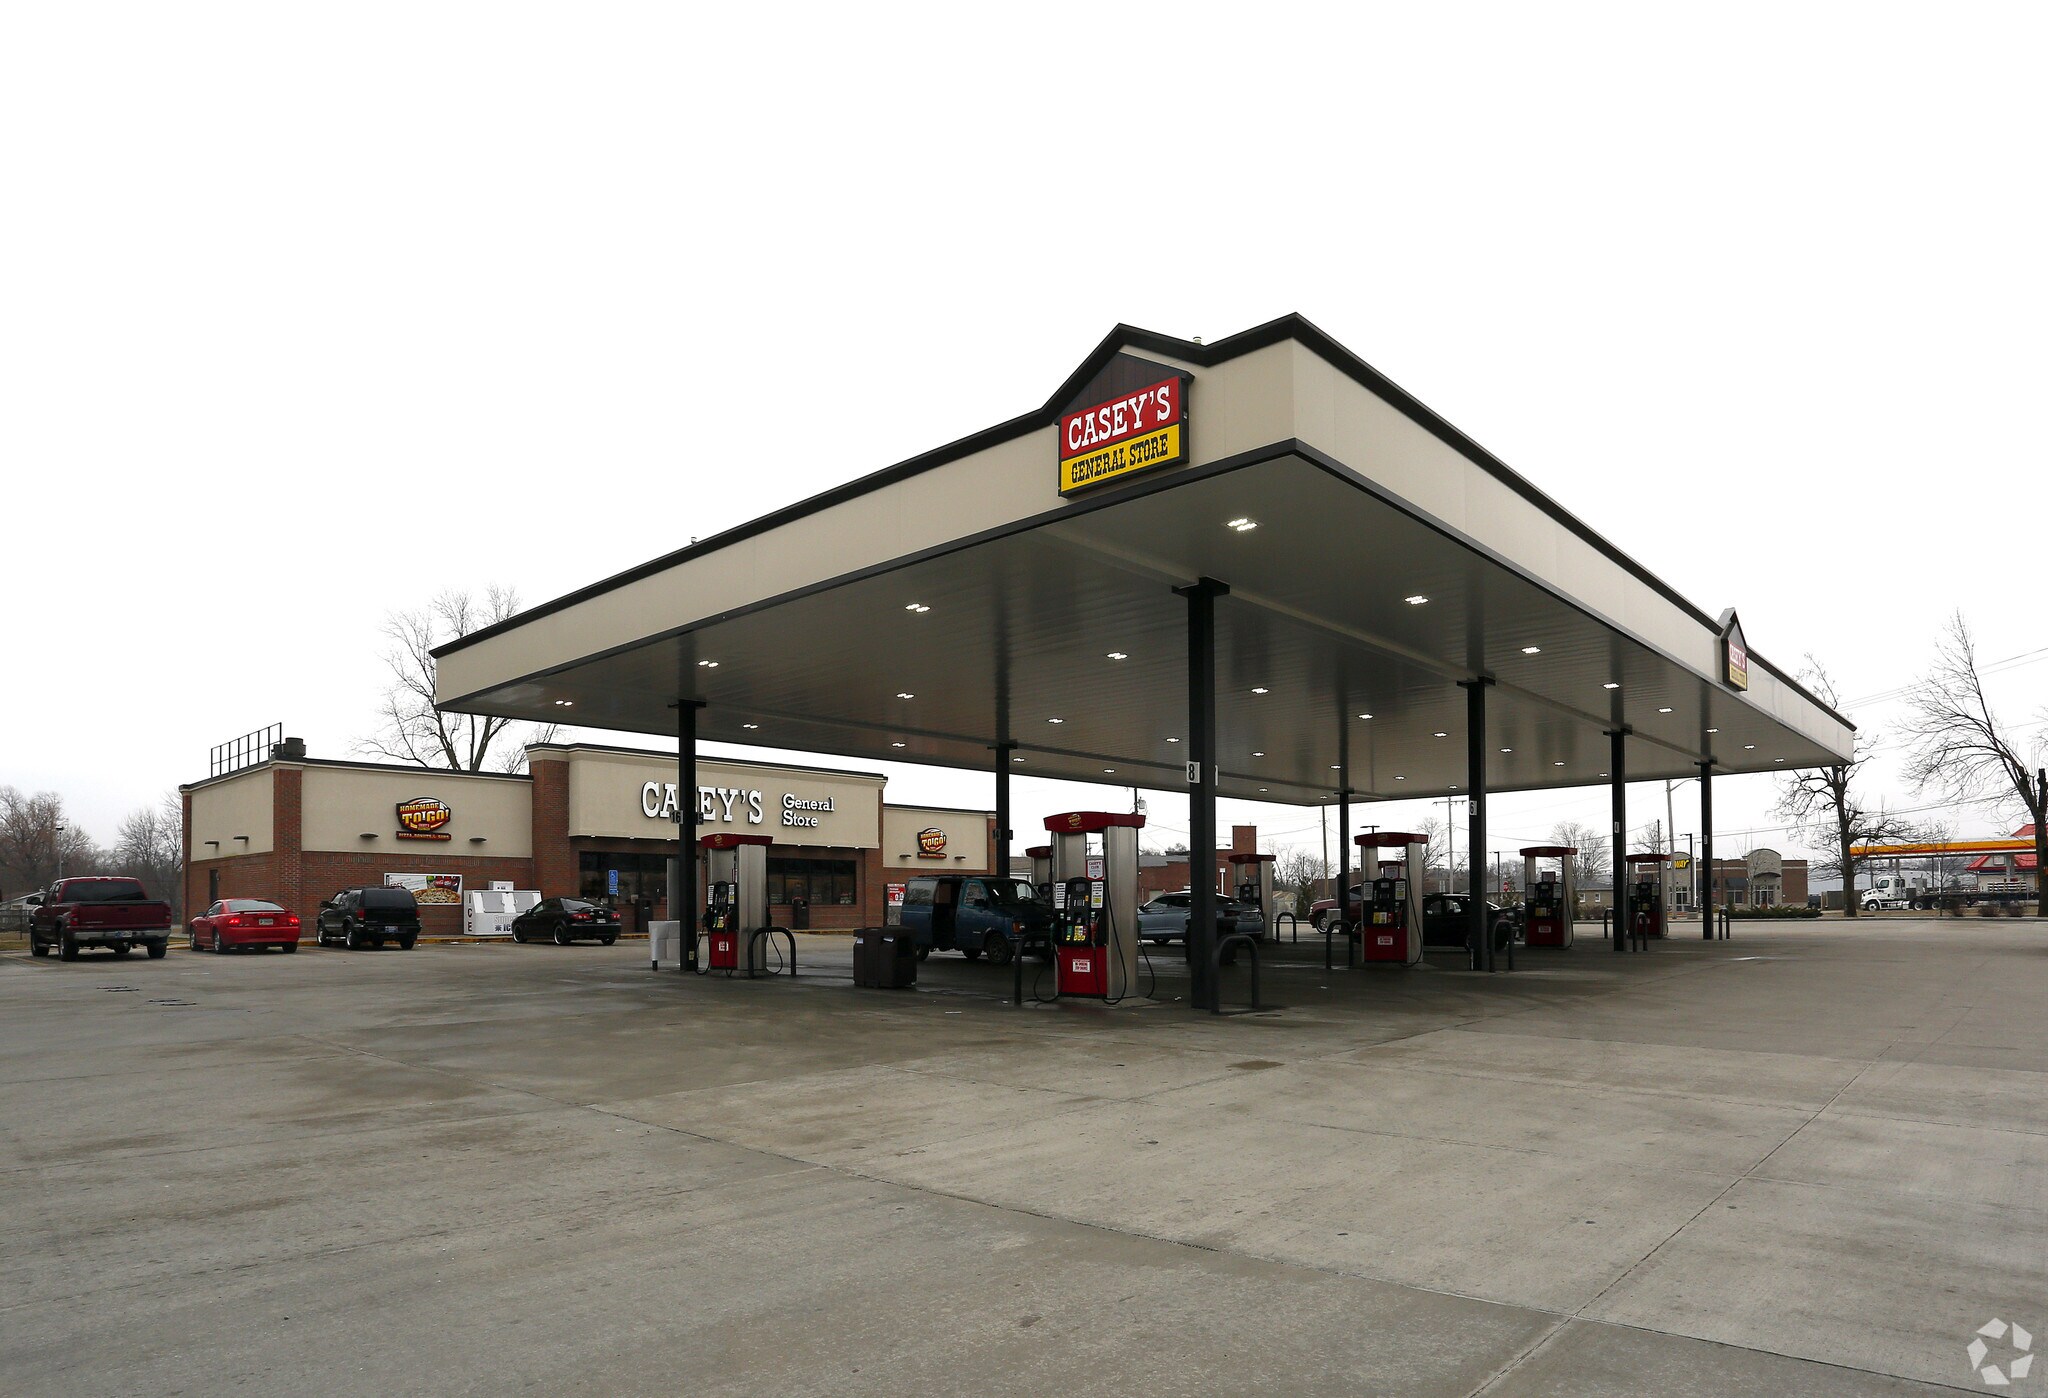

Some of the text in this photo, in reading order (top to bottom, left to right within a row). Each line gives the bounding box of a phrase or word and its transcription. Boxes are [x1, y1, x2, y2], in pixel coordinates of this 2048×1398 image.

[1068, 385, 1171, 450] CASEY'S
[1071, 433, 1168, 483] GENERAL STORE
[1188, 763, 1195, 781] 8
[400, 802, 440, 812] HOMEMADE
[642, 781, 763, 824] CAEY'S
[782, 793, 835, 812] General
[671, 811, 681, 823] 16
[782, 810, 818, 828] Store
[503, 924, 513, 932] IC
